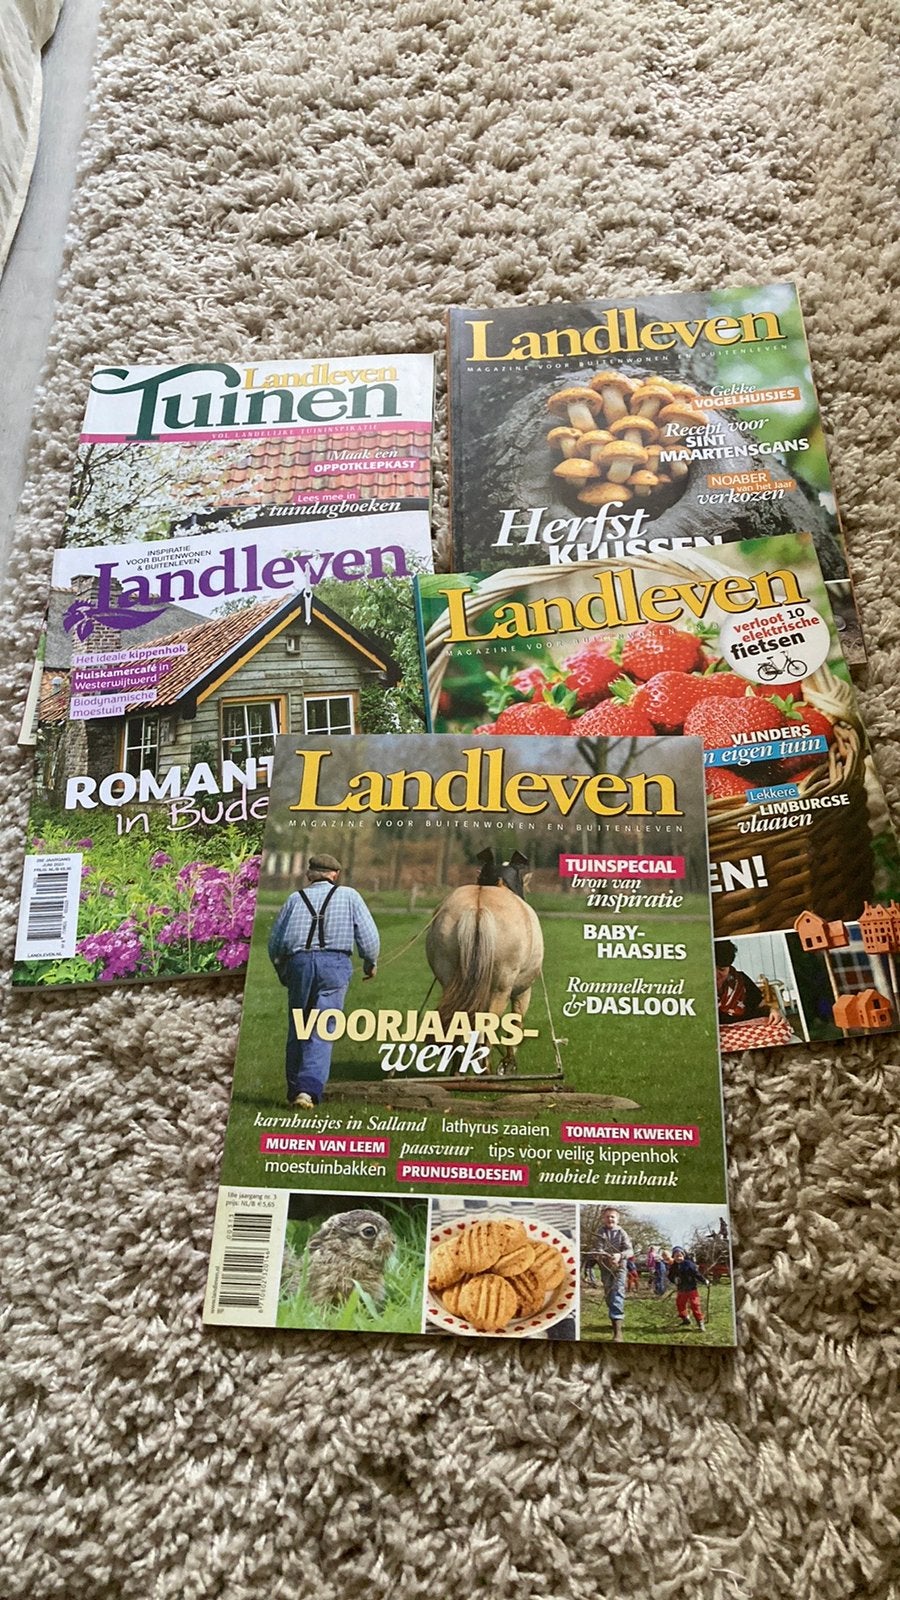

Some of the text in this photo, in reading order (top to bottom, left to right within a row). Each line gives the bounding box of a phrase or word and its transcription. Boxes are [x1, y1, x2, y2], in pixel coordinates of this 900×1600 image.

[465, 307, 788, 361] Landleven
[579, 355, 669, 368] BUITENWONEN
[701, 344, 788, 357] BUITENLEVEN
[241, 363, 399, 390] Landleven
[694, 389, 795, 409] VOGELHUISJES
[710, 383, 756, 397] Gekke
[91, 363, 402, 440] Tuinen
[665, 418, 769, 441] Recept voor
[660, 438, 810, 463] MAARTENSGANS
[686, 434, 727, 448] SINT
[329, 450, 399, 461] Maak een
[314, 460, 417, 473] OPPOTKLEPKAST
[711, 473, 768, 486] NOABER
[756, 482, 772, 491] het
[298, 492, 356, 503] Lees mee in
[697, 488, 785, 505] verkozen
[268, 499, 401, 519] tuindagboeken
[491, 501, 650, 553] Herfst
[126, 549, 212, 566] VOOR BUITENWONEN
[147, 545, 191, 556] INSPIRATIE
[145, 558, 200, 571] BUITENLEVEN
[94, 544, 413, 610] Landleven
[439, 567, 811, 644] Landleven
[733, 612, 785, 634] verloot
[787, 608, 805, 620] 10
[742, 616, 820, 642] elektrische
[76, 645, 186, 664] Het ideale kippenhok
[445, 645, 516, 657] MAGAZINE
[526, 640, 564, 651] VOOR
[730, 633, 806, 660] fietsen
[75, 663, 169, 680] Huiskamercafé in
[74, 674, 158, 690] Westerwijtwerd
[73, 691, 155, 707] Biodynamische
[72, 706, 123, 717] moestuin
[731, 724, 812, 745] VLINDERS
[721, 745, 773, 767] eigen
[779, 737, 822, 757] tuin
[289, 747, 684, 816] Landleven
[750, 788, 797, 802] Lekkere
[759, 794, 851, 816] LIMBURGSE
[116, 812, 150, 836] in
[288, 820, 683, 833] MAGAZINE VOOR BUITENWONEN EN BUITENLEVEN
[737, 812, 813, 834] vlaaien
[565, 859, 677, 874] TUINSPECIAL
[572, 874, 642, 889] bron van
[587, 889, 683, 913] inspiratie
[583, 924, 645, 940] BABY-
[597, 943, 687, 960] HAASJES
[566, 976, 685, 995] Rommelkruid
[292, 1008, 539, 1046] VOORJAARS-
[378, 1031, 490, 1074] werk
[254, 1112, 428, 1134] karnhuisjes in Salland
[442, 1118, 550, 1137] lathyrus zaaien
[566, 1126, 693, 1141] TOMATEN KWEKEN
[266, 1138, 385, 1153] MUREN VAN LEEM
[399, 1142, 474, 1159] paasvuur
[488, 1144, 679, 1165] tips voor veilig kippenhok
[264, 1160, 386, 1177] moestuinbakken
[402, 1165, 523, 1182] PRUNUSBLOESEM
[539, 1168, 678, 1187] mobiele tuinbank
[239, 1193, 262, 1201] jaargang
